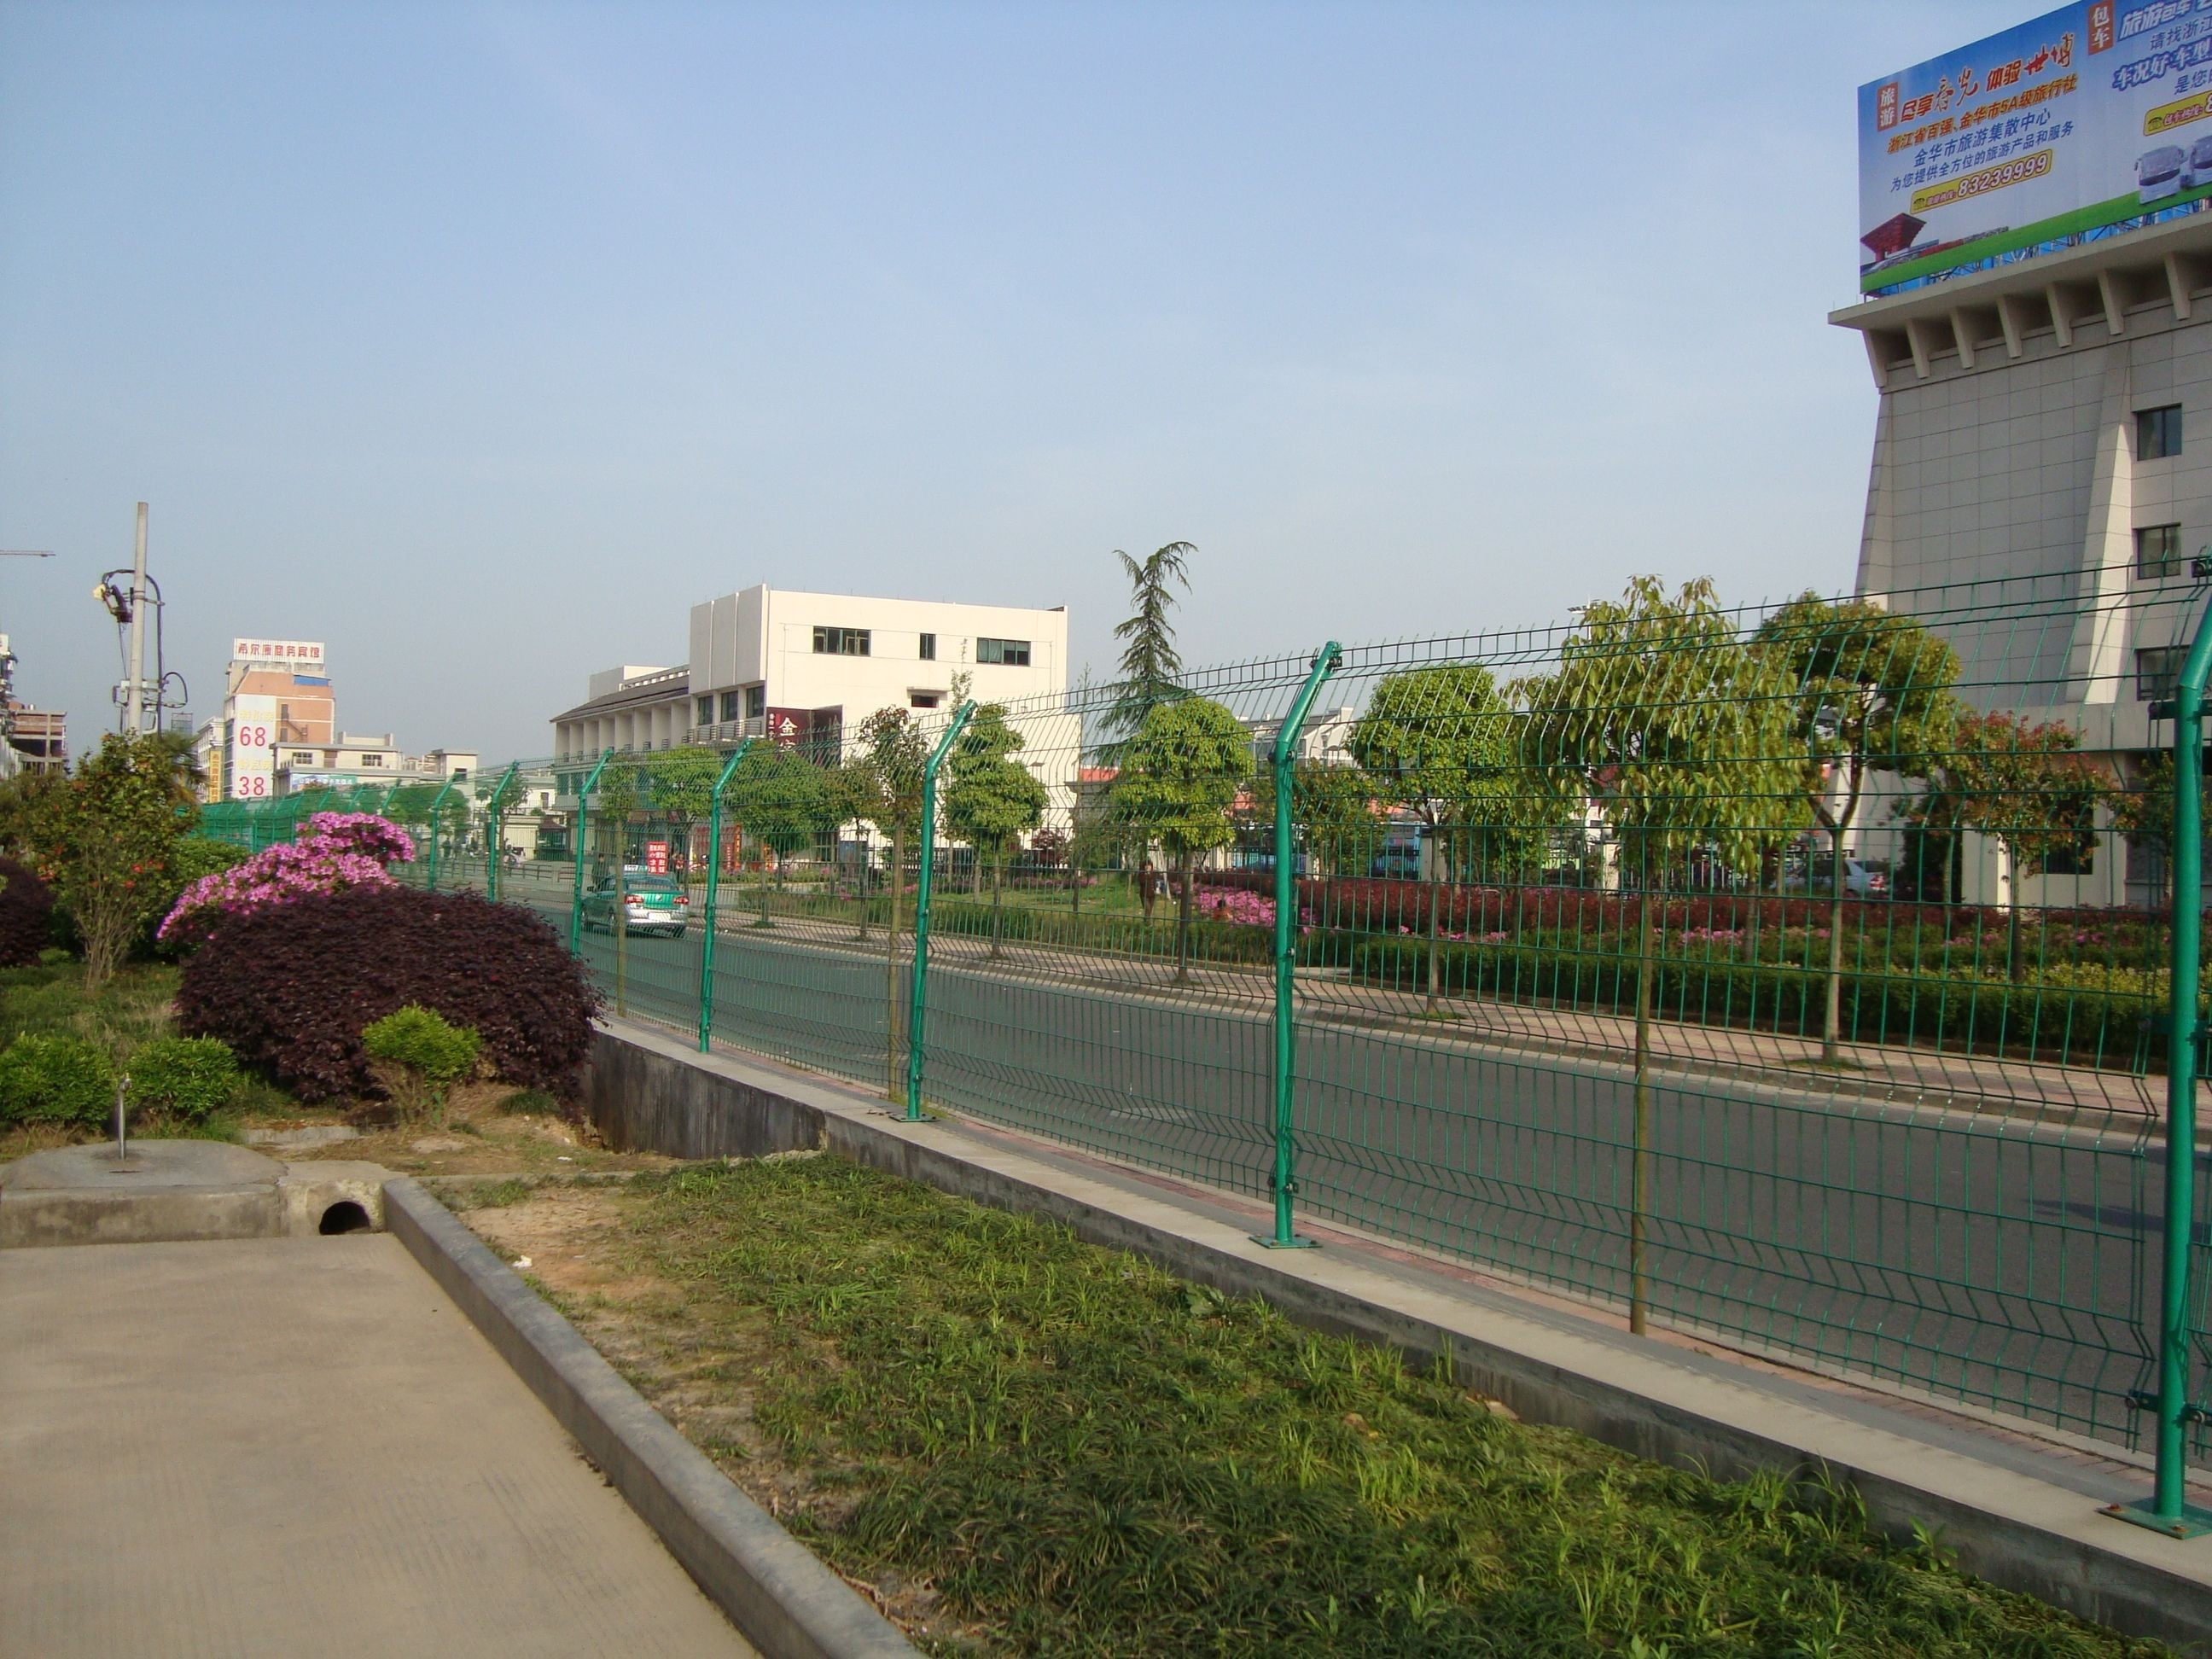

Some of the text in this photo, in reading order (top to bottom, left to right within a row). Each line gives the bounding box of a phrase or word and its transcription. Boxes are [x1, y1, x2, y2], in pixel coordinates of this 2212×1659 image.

[2092, 6, 2110, 49] 包车
[1986, 32, 2074, 92] 体验世博
[2174, 68, 2212, 95] 是您
[1879, 86, 1896, 127] 旅游
[1890, 120, 2074, 193] 为您提供全方位的旅游产品和服务
[1913, 108, 2051, 167] 金华市旅游集散中心
[1958, 153, 2047, 198] 83239999
[240, 726, 265, 746] 68
[238, 776, 265, 795] 38
